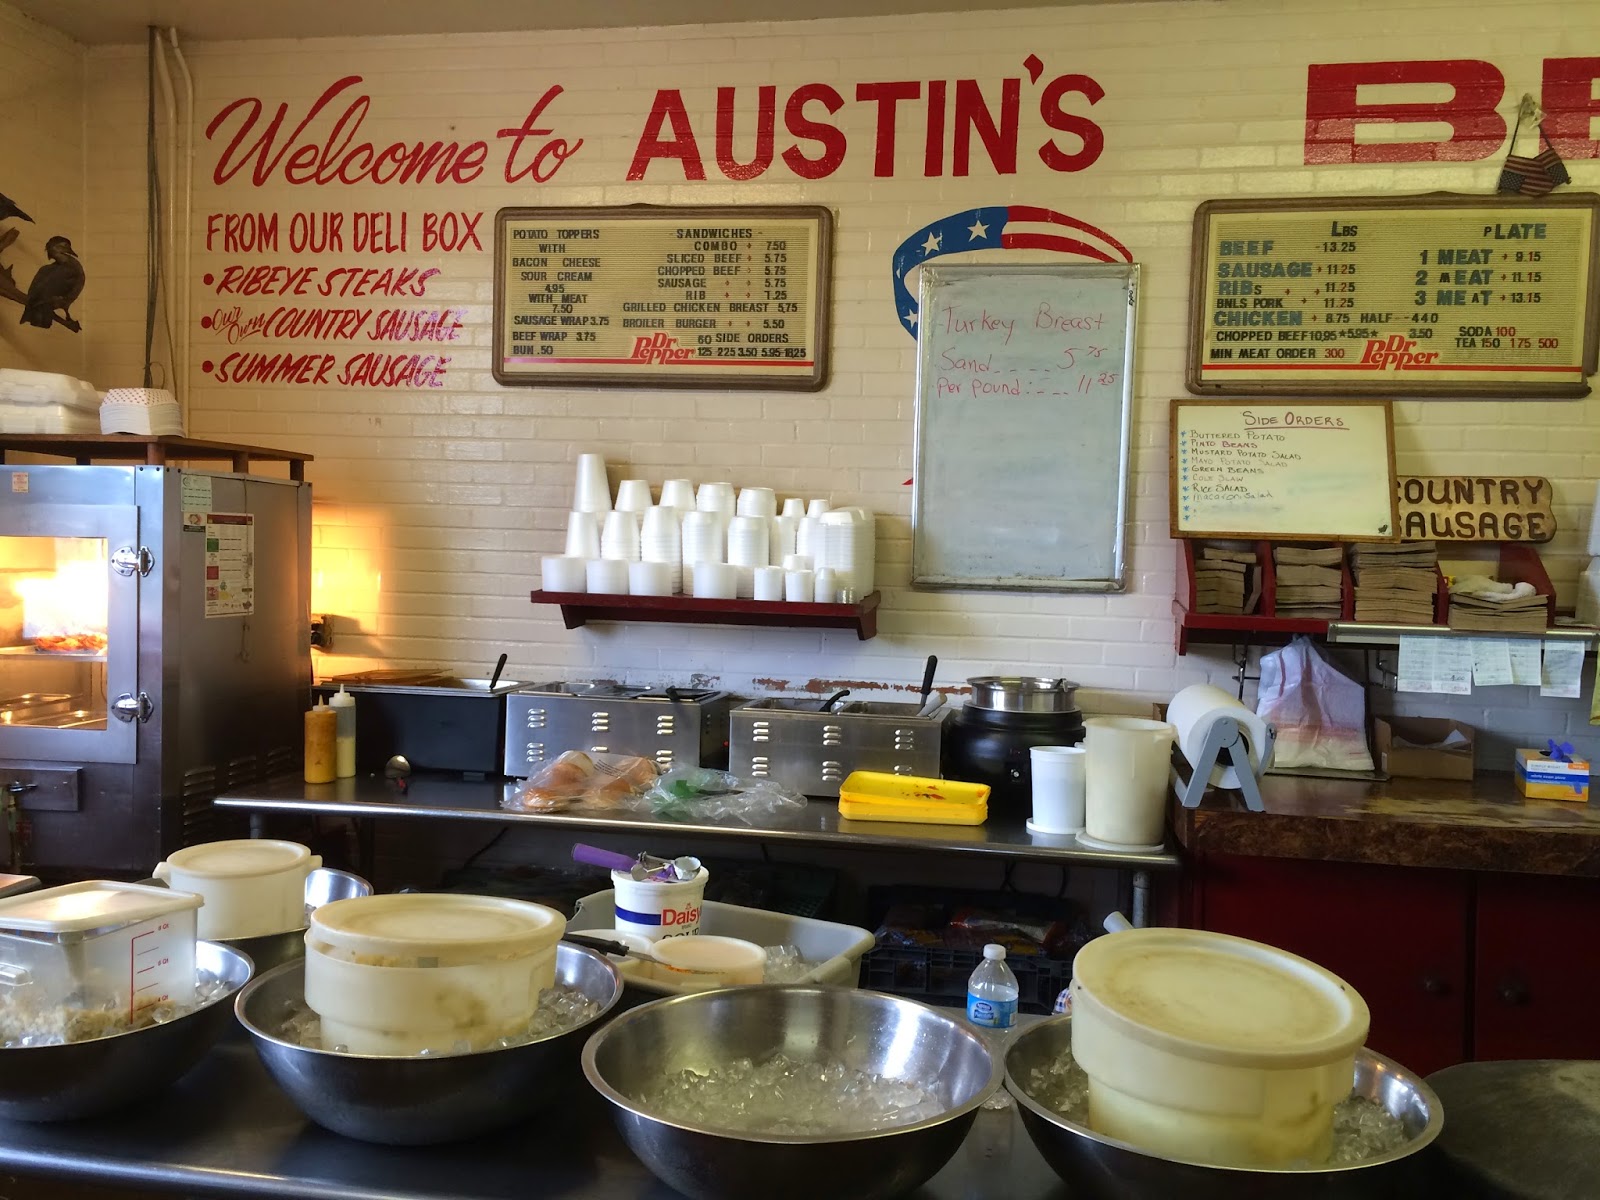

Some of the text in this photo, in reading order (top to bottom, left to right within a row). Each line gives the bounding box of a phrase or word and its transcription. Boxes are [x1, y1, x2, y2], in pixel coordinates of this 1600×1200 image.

[206, 75, 488, 187] Welcome
[496, 85, 583, 184] to
[626, 53, 1105, 181] AUSTIN'S
[207, 211, 484, 253] FROM OUR DELI BOX
[513, 229, 600, 239] POTATO TOPPERS
[676, 228, 753, 239] SANDWICHES
[538, 244, 566, 253] WITH
[694, 241, 738, 251] COMBO
[1219, 240, 1356, 256] BEEF 13.25
[512, 258, 601, 267] BACON CHEESE
[666, 253, 787, 264] SLICED BEEF 5.75
[1419, 250, 1428, 265] 1
[1437, 249, 1493, 265] MEAT
[657, 266, 786, 276] CHOPPED BEEF 5.75
[1217, 262, 1313, 278] SAUSAGE
[216, 265, 442, 297] RIBEYE STEAKS
[520, 272, 593, 281] SOUR CREAM
[1415, 270, 1428, 285] 2
[1439, 270, 1494, 285] MEAT
[657, 278, 786, 288] SAUSAGE 5.75
[528, 294, 588, 303] WITH MEAT
[685, 291, 706, 300] RIB
[1414, 290, 1427, 306] 3
[1436, 290, 1493, 306] MEAT
[623, 303, 666, 312] GRILLED
[674, 303, 720, 312] CHICKEN
[729, 302, 769, 312] BREAST
[1216, 298, 1247, 308] BNLS
[1253, 298, 1283, 308] PORK
[552, 304, 573, 314] 7.50
[263, 307, 373, 340] COUNTRY
[367, 309, 468, 341] SAUSAGE
[513, 316, 610, 326] SAUSAGE WRAP 3.75
[622, 318, 785, 329] BROILER BURGER 5.50
[941, 302, 1105, 345] Turkey Breast
[1213, 311, 1303, 326] CHICKEN
[1360, 313, 1393, 323] HALF
[512, 332, 536, 341] BEEF
[540, 332, 567, 341] WRAP
[715, 333, 740, 343] SIDE
[747, 333, 789, 343] ORDERS
[1216, 331, 1272, 341] CHOPPED
[1278, 331, 1309, 341] BEEF
[1459, 326, 1492, 337] SODA
[650, 332, 679, 348] Dr
[1384, 335, 1417, 353] Dr
[1455, 338, 1476, 348] TEA
[513, 345, 534, 355] BUN
[631, 336, 695, 364] Pepper
[1210, 348, 1232, 359] MIN
[1238, 348, 1271, 358] MEAT
[1276, 348, 1316, 359] ORDER
[1360, 340, 1439, 371] Pepper
[941, 347, 992, 372] Sand
[215, 352, 451, 387] SUMMER SAUSAGE
[1397, 479, 1544, 505] OUNTRY
[1399, 511, 1546, 539] AUSAGE
